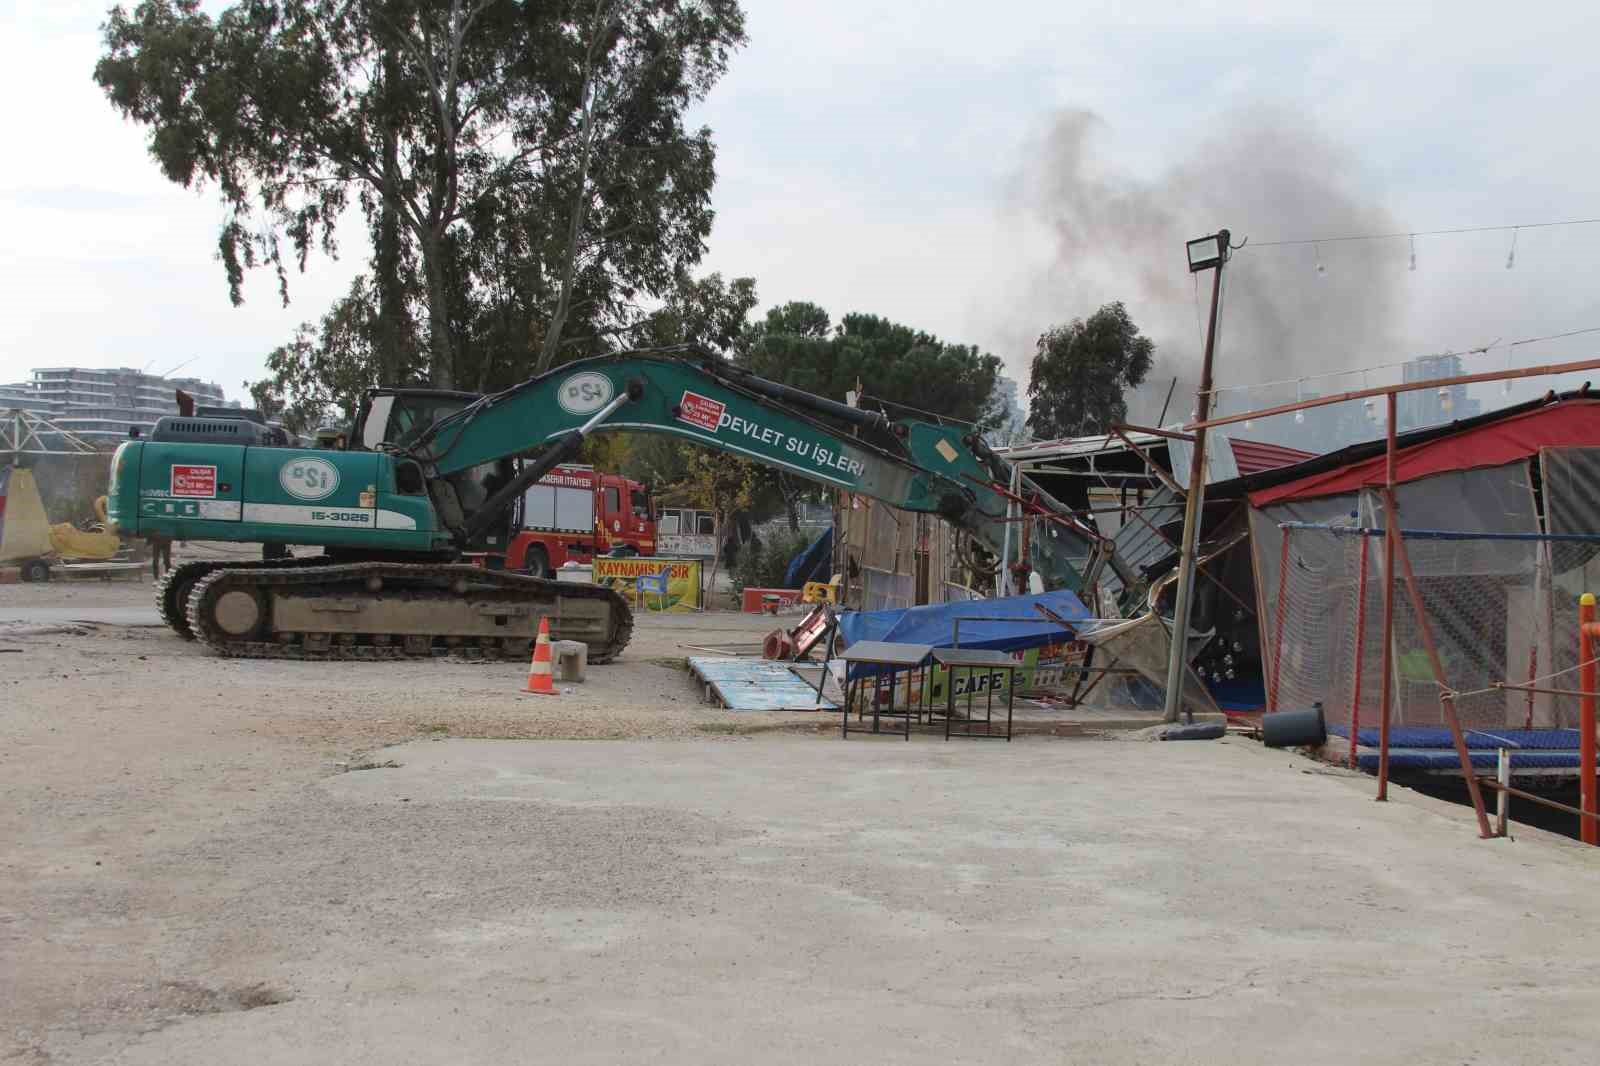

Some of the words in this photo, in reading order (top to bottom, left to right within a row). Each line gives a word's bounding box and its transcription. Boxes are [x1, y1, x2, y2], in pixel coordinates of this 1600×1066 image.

[719, 413, 784, 447] DEVLET
[785, 437, 810, 456] SU
[954, 672, 1004, 695] CAFE
